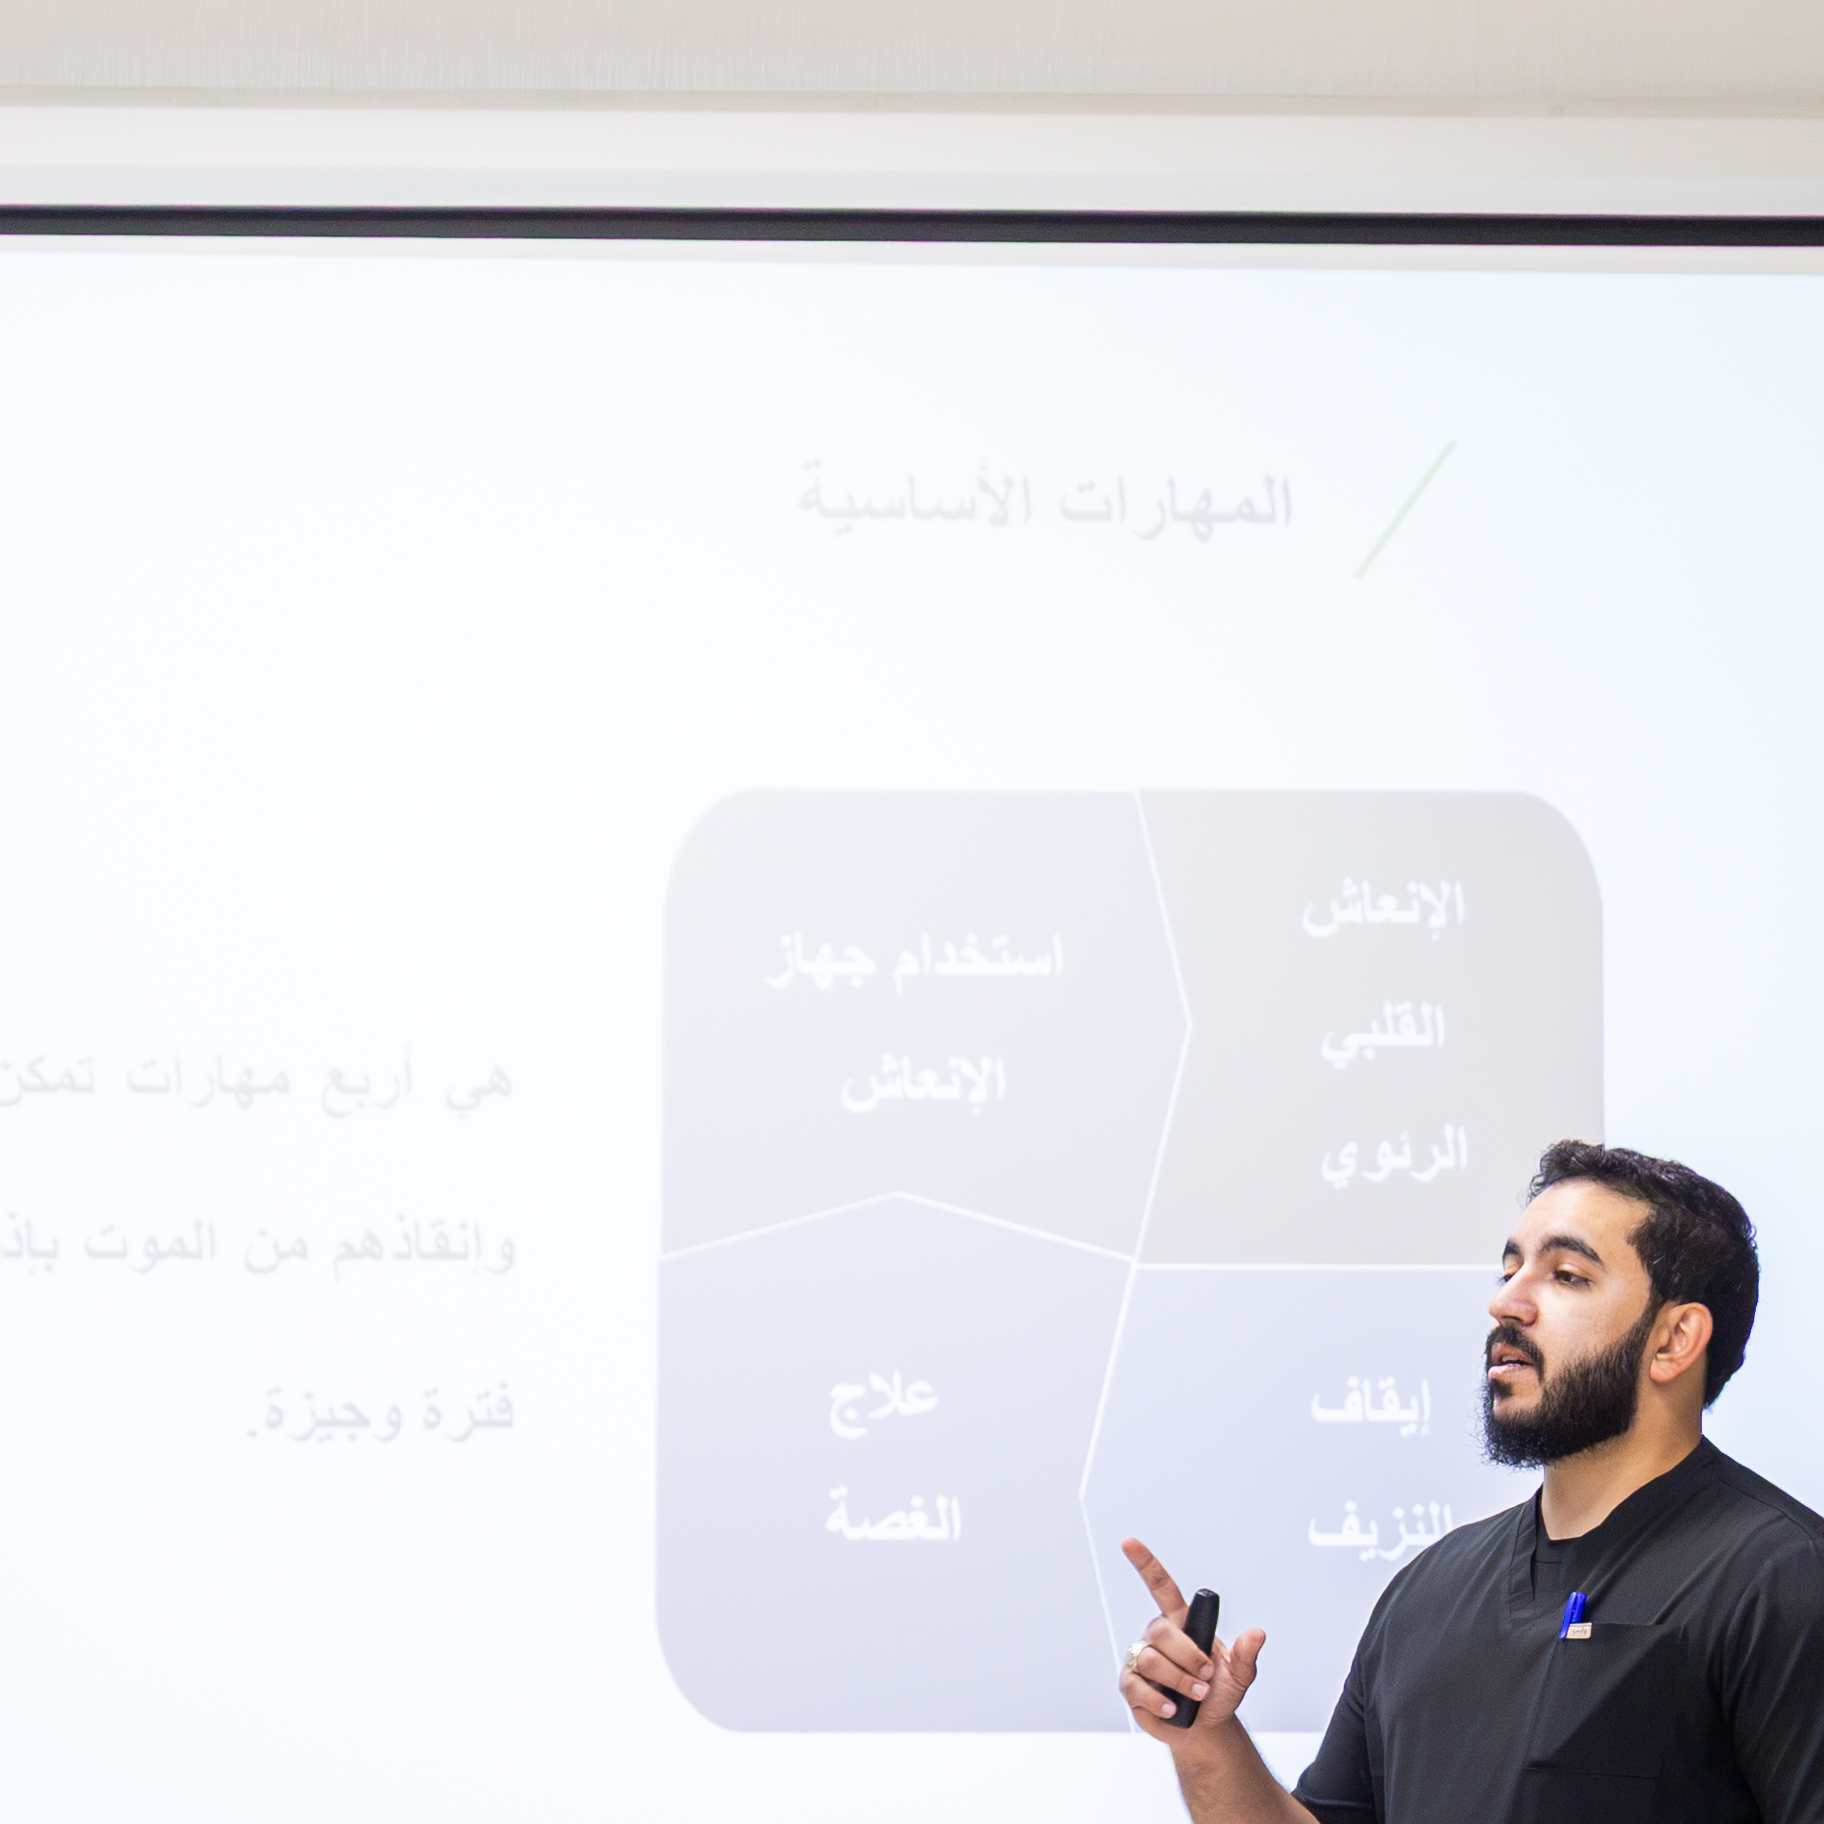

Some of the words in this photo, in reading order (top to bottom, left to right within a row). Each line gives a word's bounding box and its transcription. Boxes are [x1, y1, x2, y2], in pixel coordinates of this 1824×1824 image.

[798, 458, 1032, 537] الأساسية
[1060, 473, 1292, 543] المهارات
[1303, 878, 1464, 940] الإنعاش
[764, 932, 876, 990] جهاز
[893, 933, 1064, 995] استخدام
[1321, 1001, 1445, 1069] القلبي
[127, 1055, 290, 1110] مهارات
[322, 1043, 412, 1119] أربع
[445, 1064, 512, 1118] هي
[841, 1053, 1005, 1115] الإنعاش
[1322, 1124, 1468, 1189] الرئوي
[84, 1219, 216, 1274] الموت
[244, 1229, 308, 1275] من
[333, 1214, 515, 1279] وإنقاذهم
[424, 1382, 513, 1443] فترة
[830, 1370, 938, 1440] علاج
[1311, 1376, 1431, 1437] إيقاف
[826, 1486, 961, 1540] الغصة
[1308, 1500, 1453, 1561] النزيف
